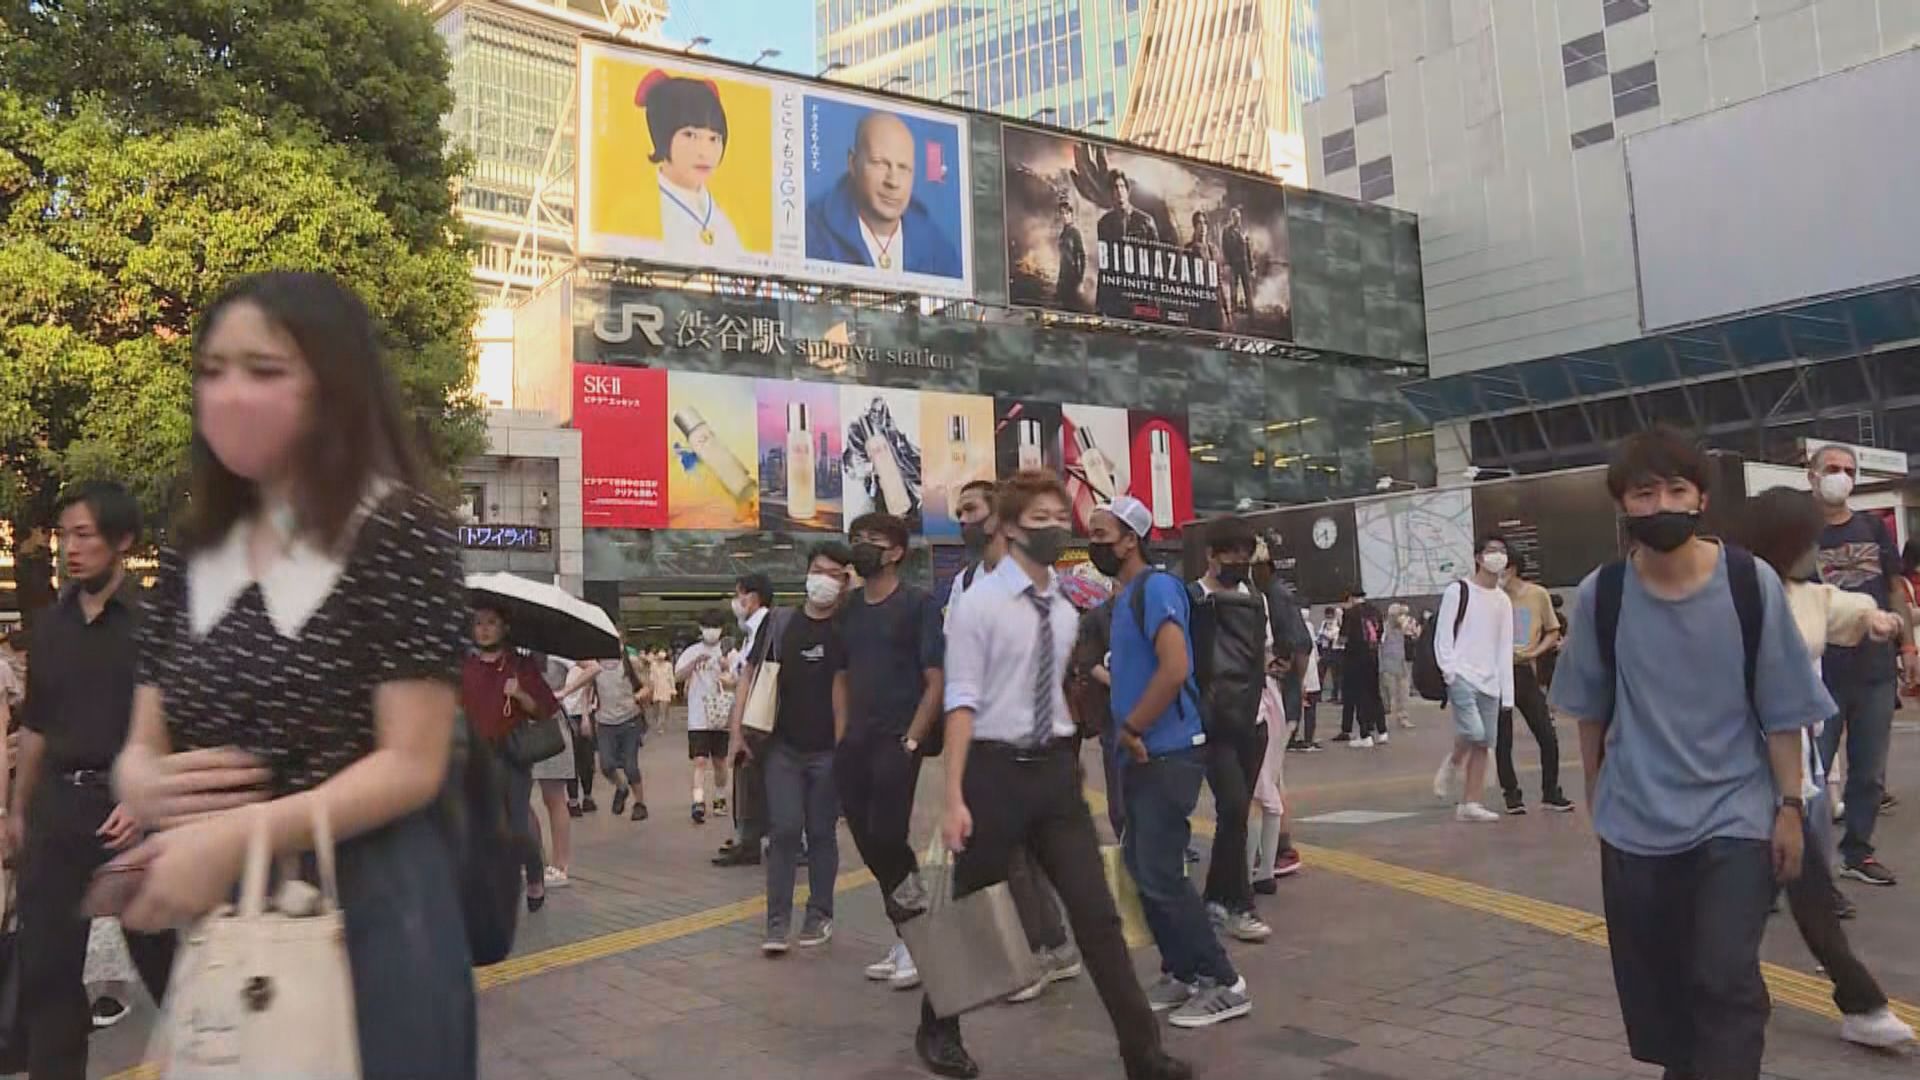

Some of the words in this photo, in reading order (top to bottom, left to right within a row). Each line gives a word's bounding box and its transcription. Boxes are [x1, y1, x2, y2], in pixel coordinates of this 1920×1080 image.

[1098, 240, 1218, 287] BIOHAZARD
[1102, 274, 1157, 291] INFINITE
[1161, 284, 1218, 301] DARKNESS
[594, 303, 665, 346] JR
[674, 309, 787, 355] 渋谷駅
[887, 347, 954, 369] station
[583, 375, 621, 395] SK-II
